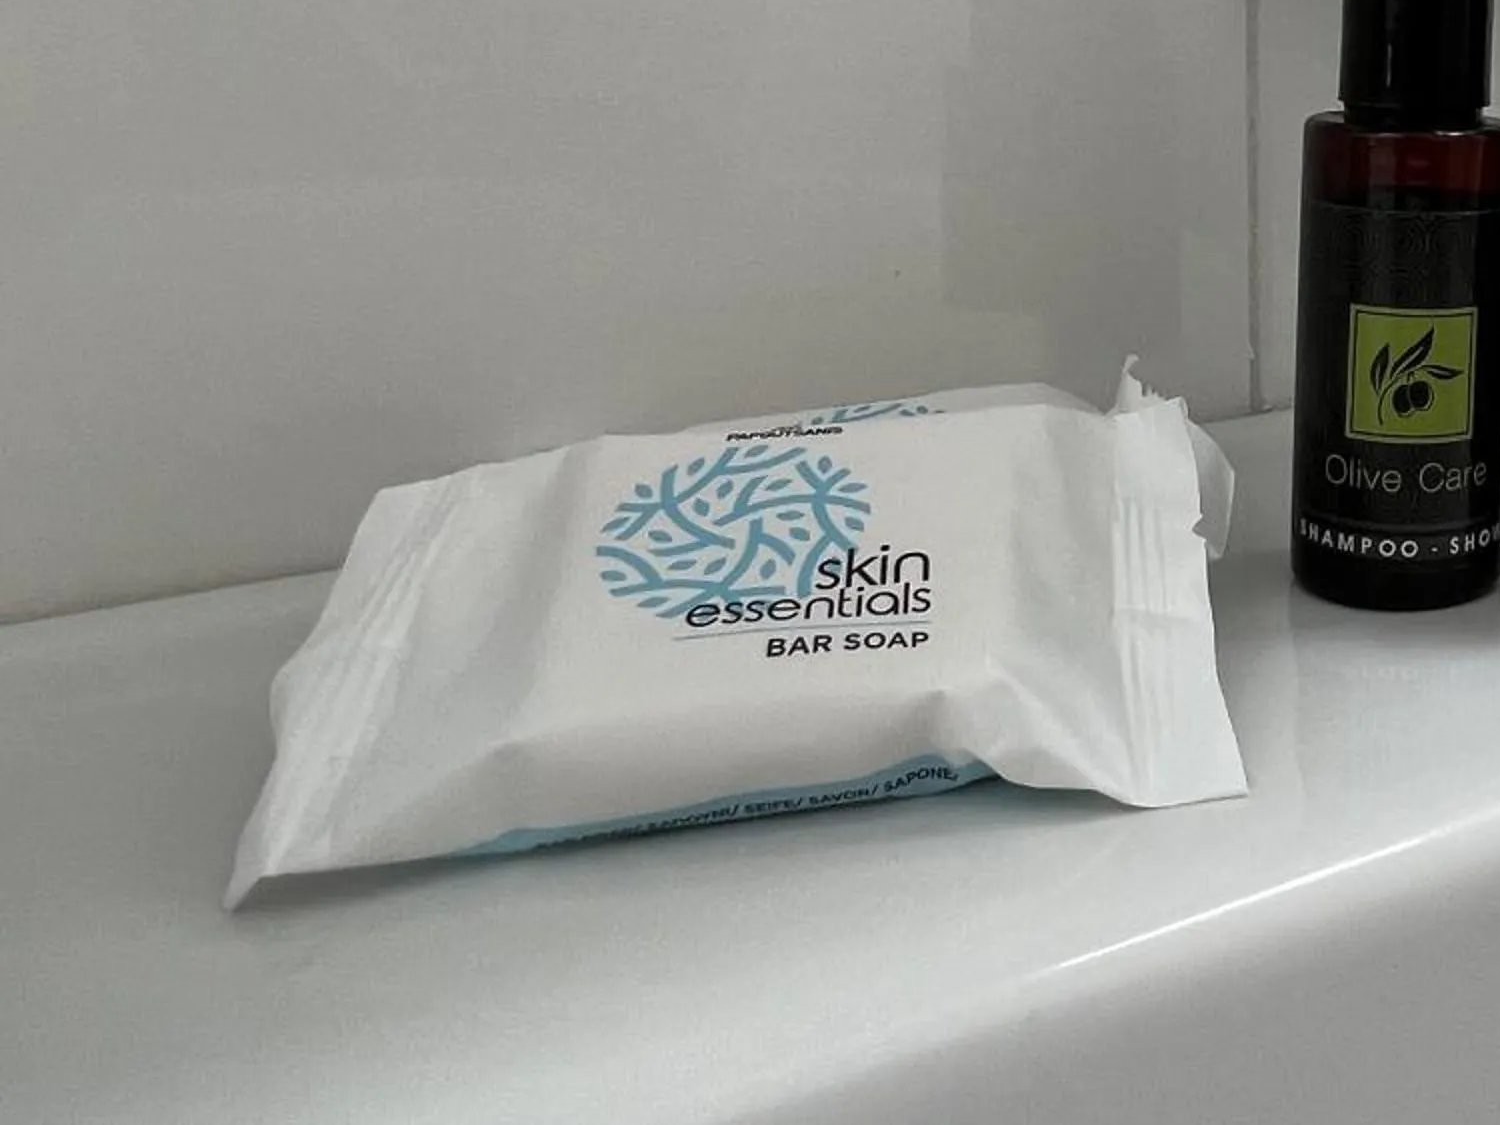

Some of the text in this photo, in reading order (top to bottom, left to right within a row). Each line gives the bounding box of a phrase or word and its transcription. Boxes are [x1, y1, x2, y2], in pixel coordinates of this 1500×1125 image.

[1325, 454, 1488, 493] Olive Care
[1301, 517, 1419, 558] SHAMPOO
[815, 544, 931, 590] skin
[685, 582, 932, 627] essentials
[765, 631, 931, 658] BAR SOAP
